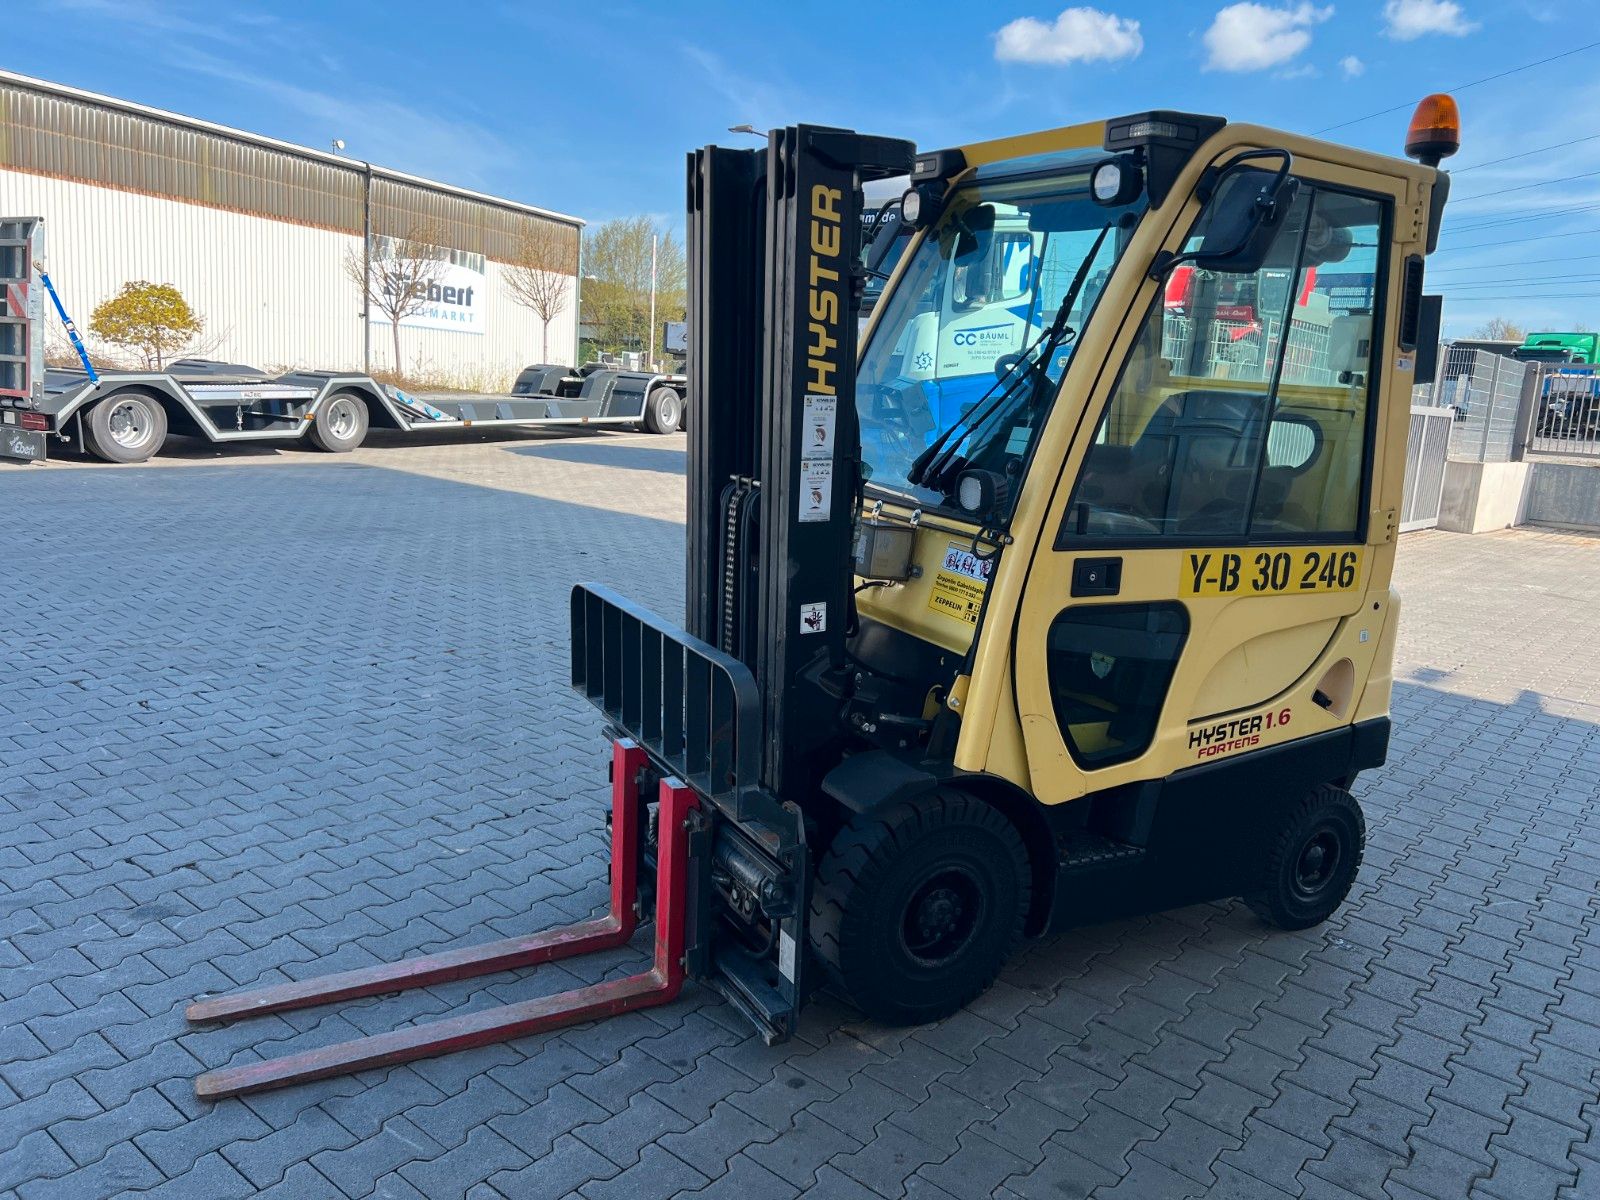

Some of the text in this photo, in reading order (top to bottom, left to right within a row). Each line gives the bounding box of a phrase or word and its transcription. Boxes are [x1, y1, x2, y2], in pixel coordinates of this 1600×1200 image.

[807, 184, 842, 395] HYSTER
[1190, 551, 1357, 593] Y-B 30 246
[935, 596, 963, 611] ZEPPELIN
[1188, 708, 1291, 749] HYSTER 1.6
[1197, 734, 1260, 759] FORTENS
